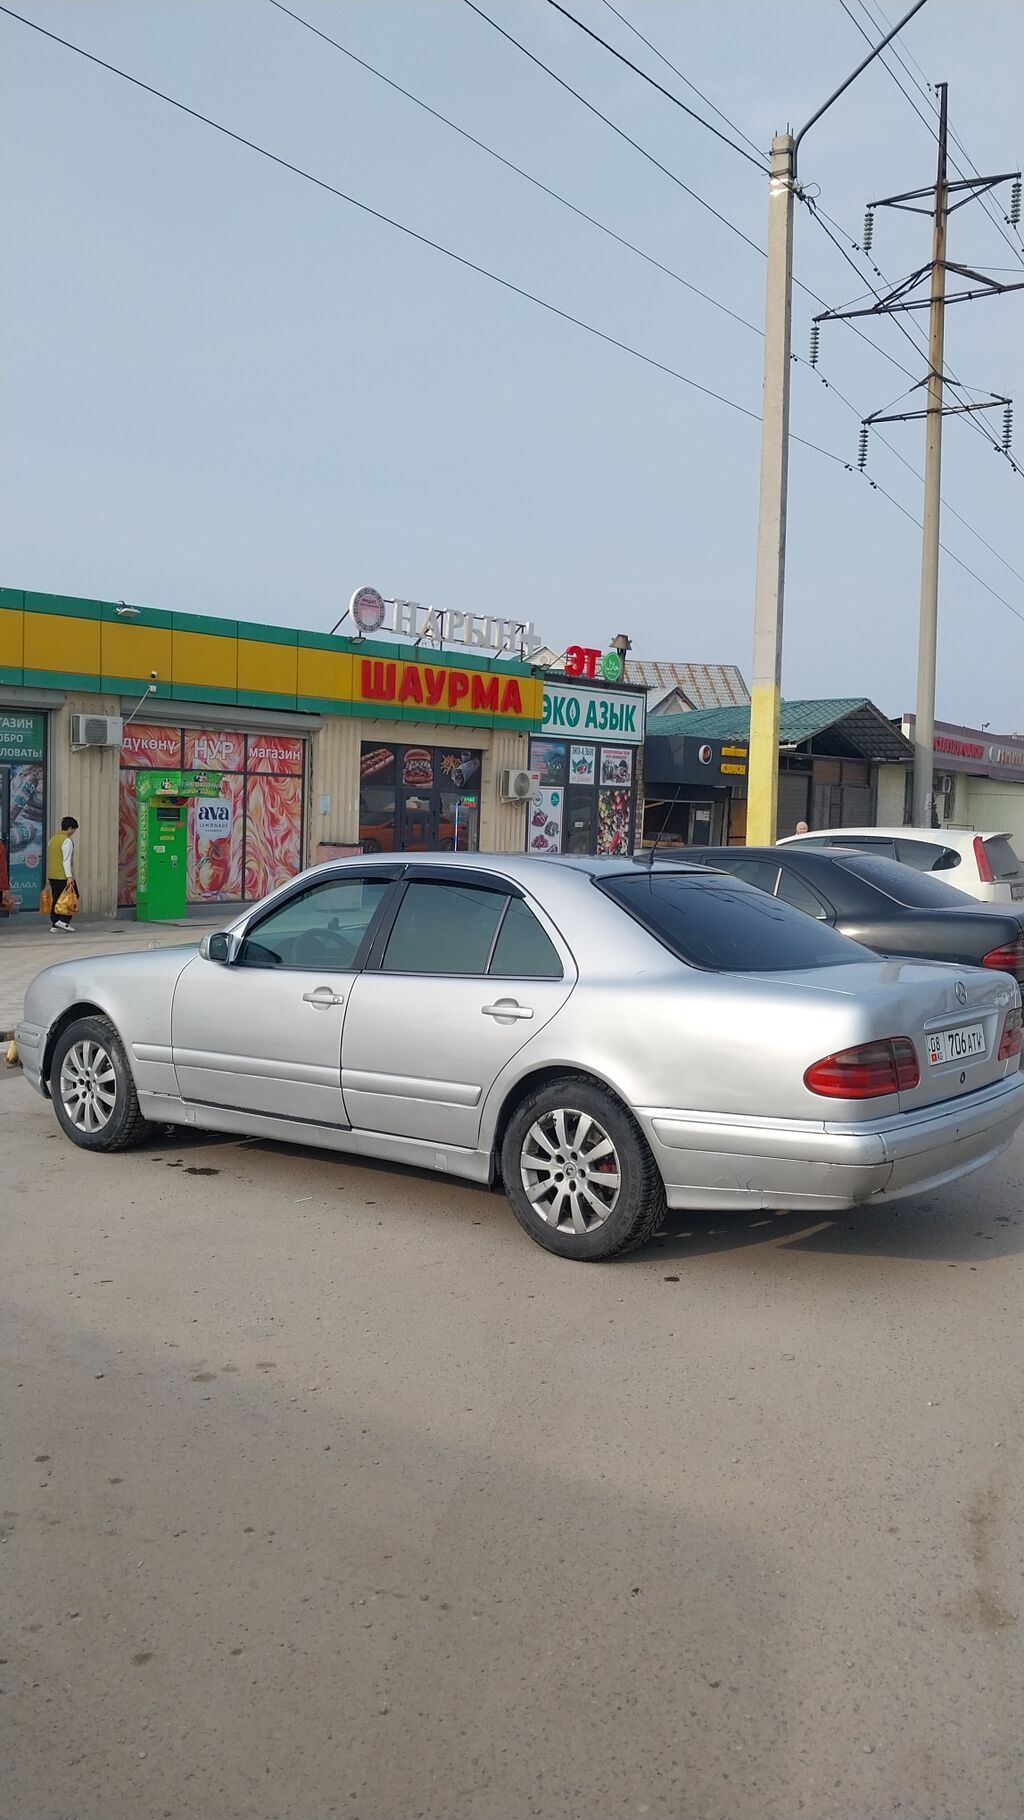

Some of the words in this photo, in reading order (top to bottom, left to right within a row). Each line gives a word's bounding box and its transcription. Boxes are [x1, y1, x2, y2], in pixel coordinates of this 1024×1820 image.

[564, 646, 602, 679] ЭТ
[361, 660, 523, 714] ШАУРМА
[541, 694, 581, 728] ЭКО
[584, 700, 637, 733] АЗЫК
[194, 738, 235, 761] НУР
[249, 747, 300, 761] магазин
[198, 805, 230, 821] ava
[930, 1036, 941, 1052] 08
